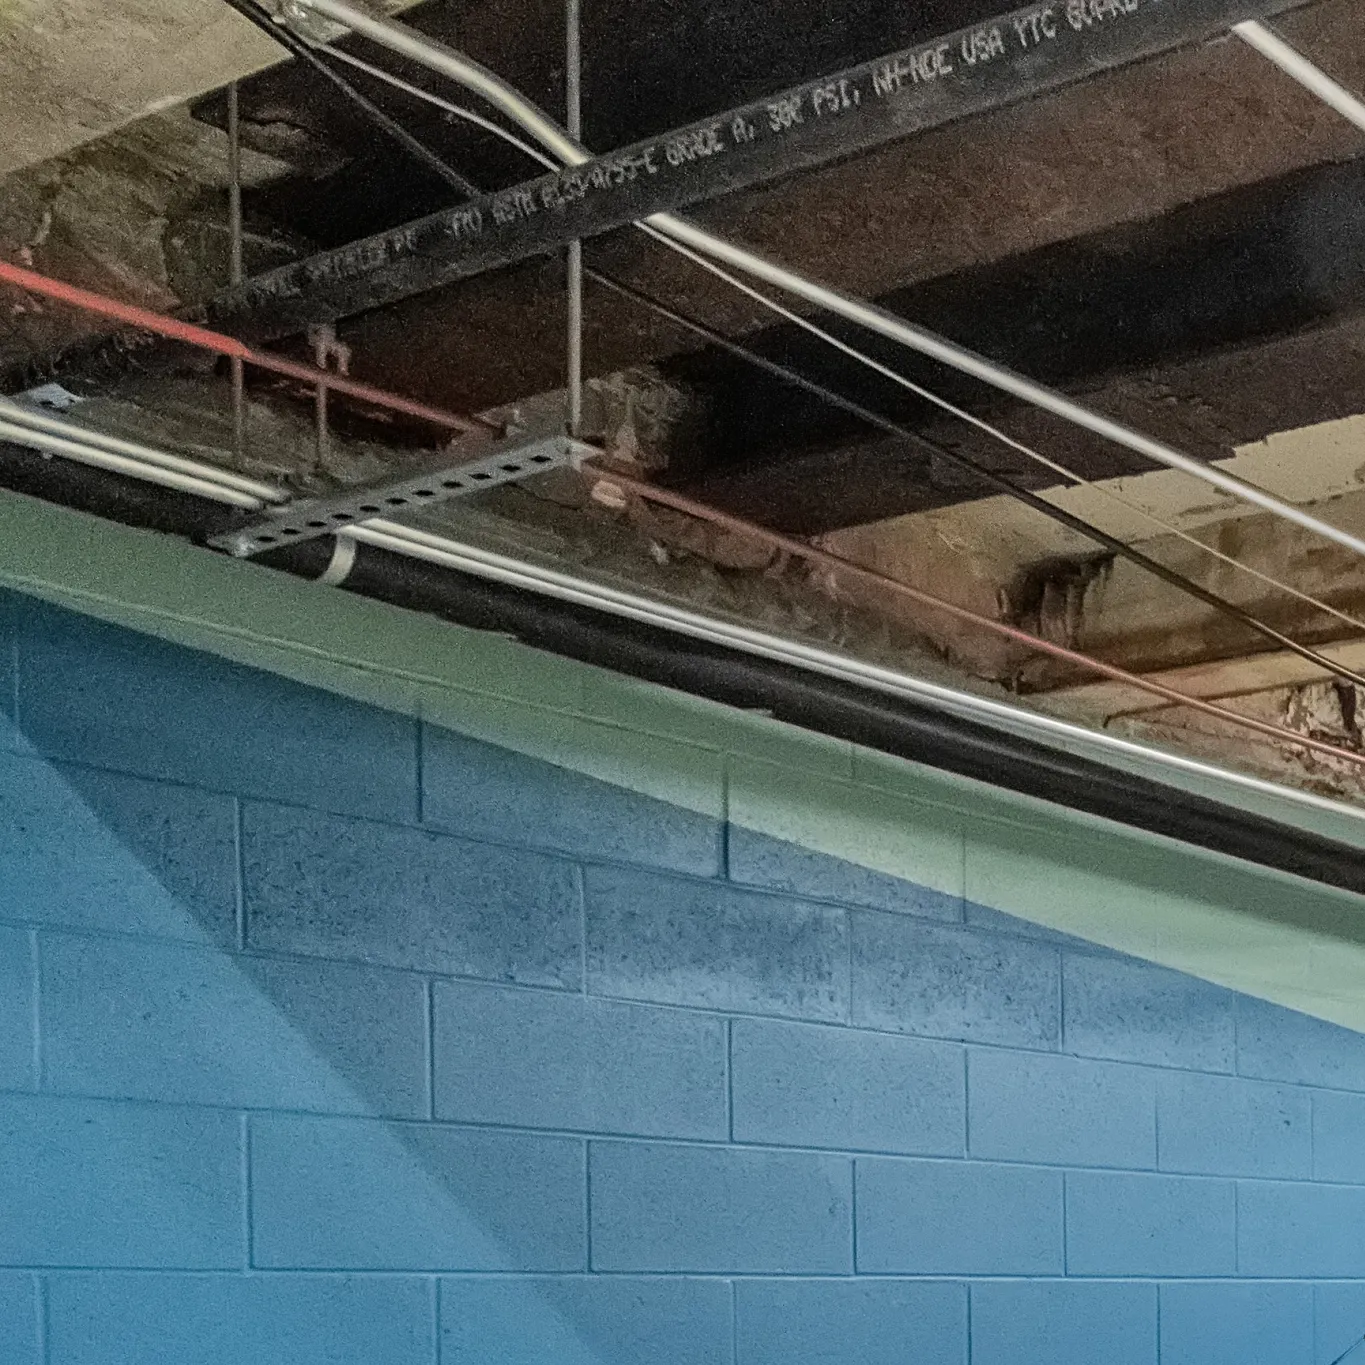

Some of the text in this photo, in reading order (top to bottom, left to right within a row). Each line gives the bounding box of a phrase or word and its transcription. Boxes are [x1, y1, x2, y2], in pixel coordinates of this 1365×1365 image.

[665, 123, 725, 166] GRADE
[961, 28, 1006, 66] USA
[1014, 8, 1057, 48] YTC
